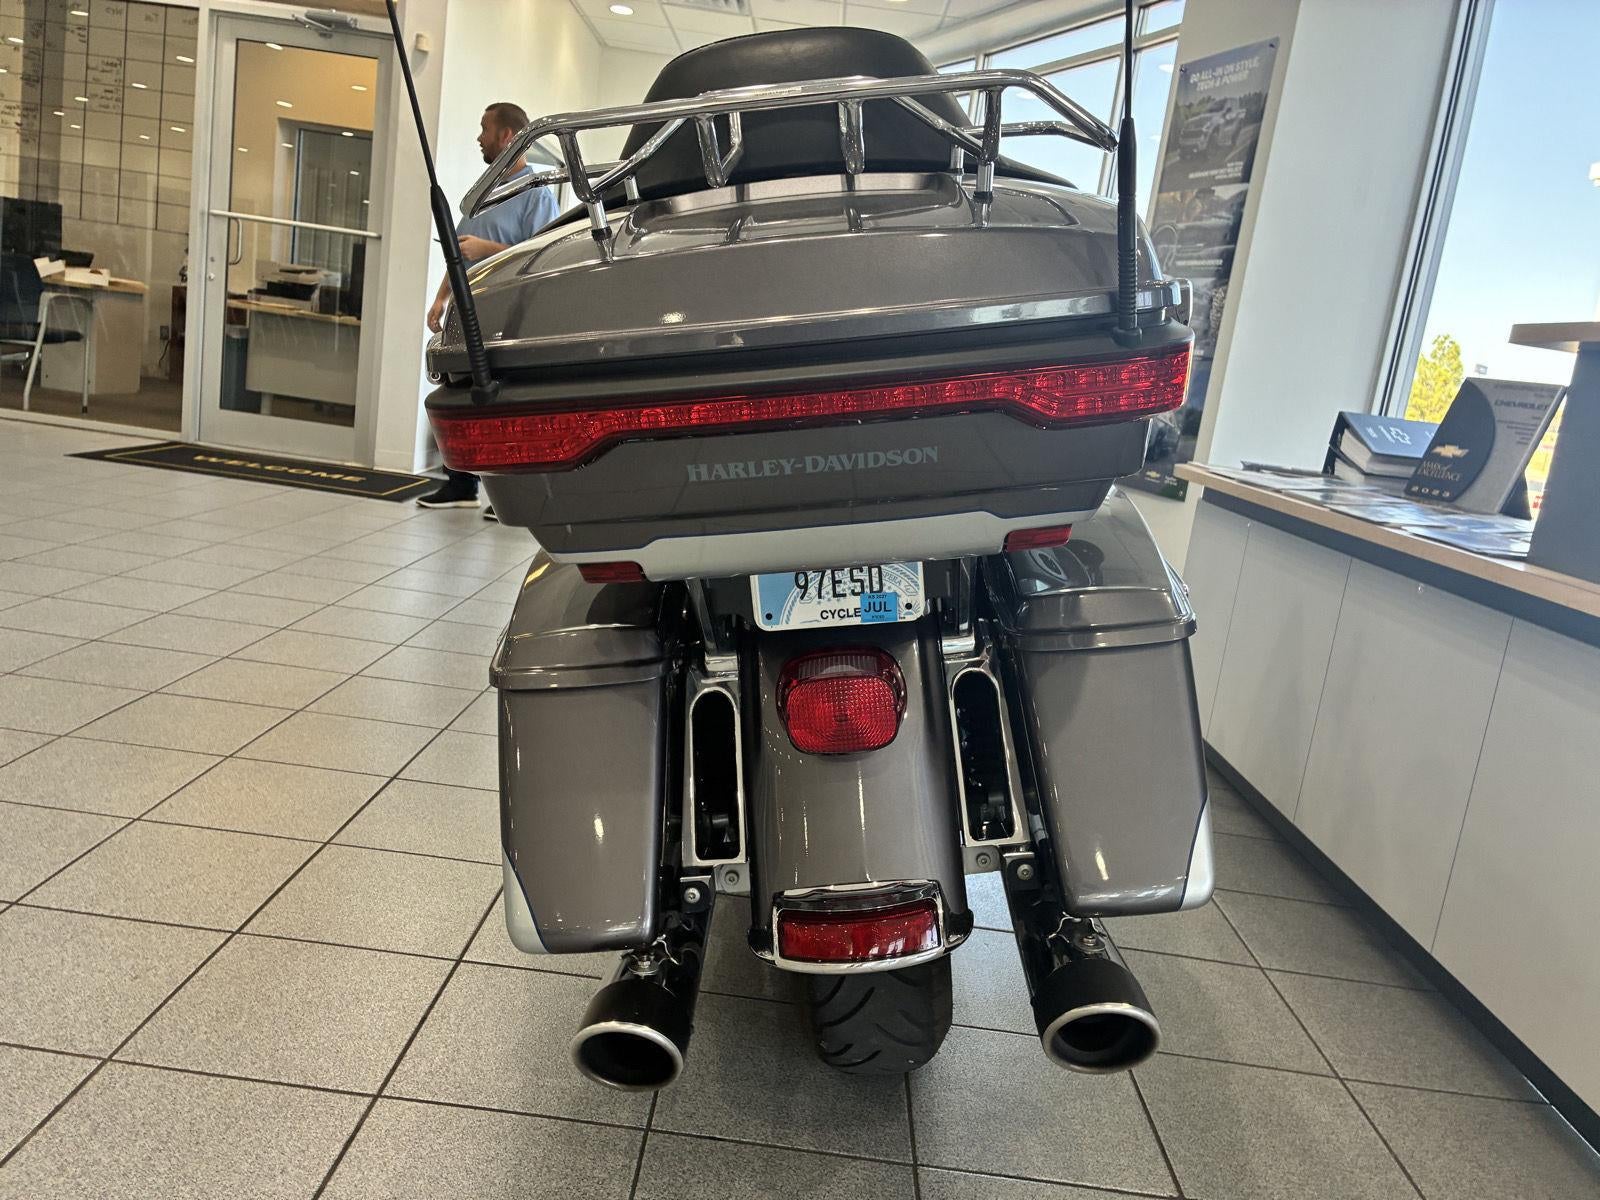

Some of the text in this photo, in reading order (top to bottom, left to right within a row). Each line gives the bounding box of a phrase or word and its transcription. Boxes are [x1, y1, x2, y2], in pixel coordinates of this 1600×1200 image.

[193, 455, 366, 482] WELCOME
[687, 446, 939, 483] HARLEY-DAVIDSON
[794, 565, 884, 600] 97ESD
[820, 607, 861, 620] CYCLE
[864, 601, 892, 613] JUL
